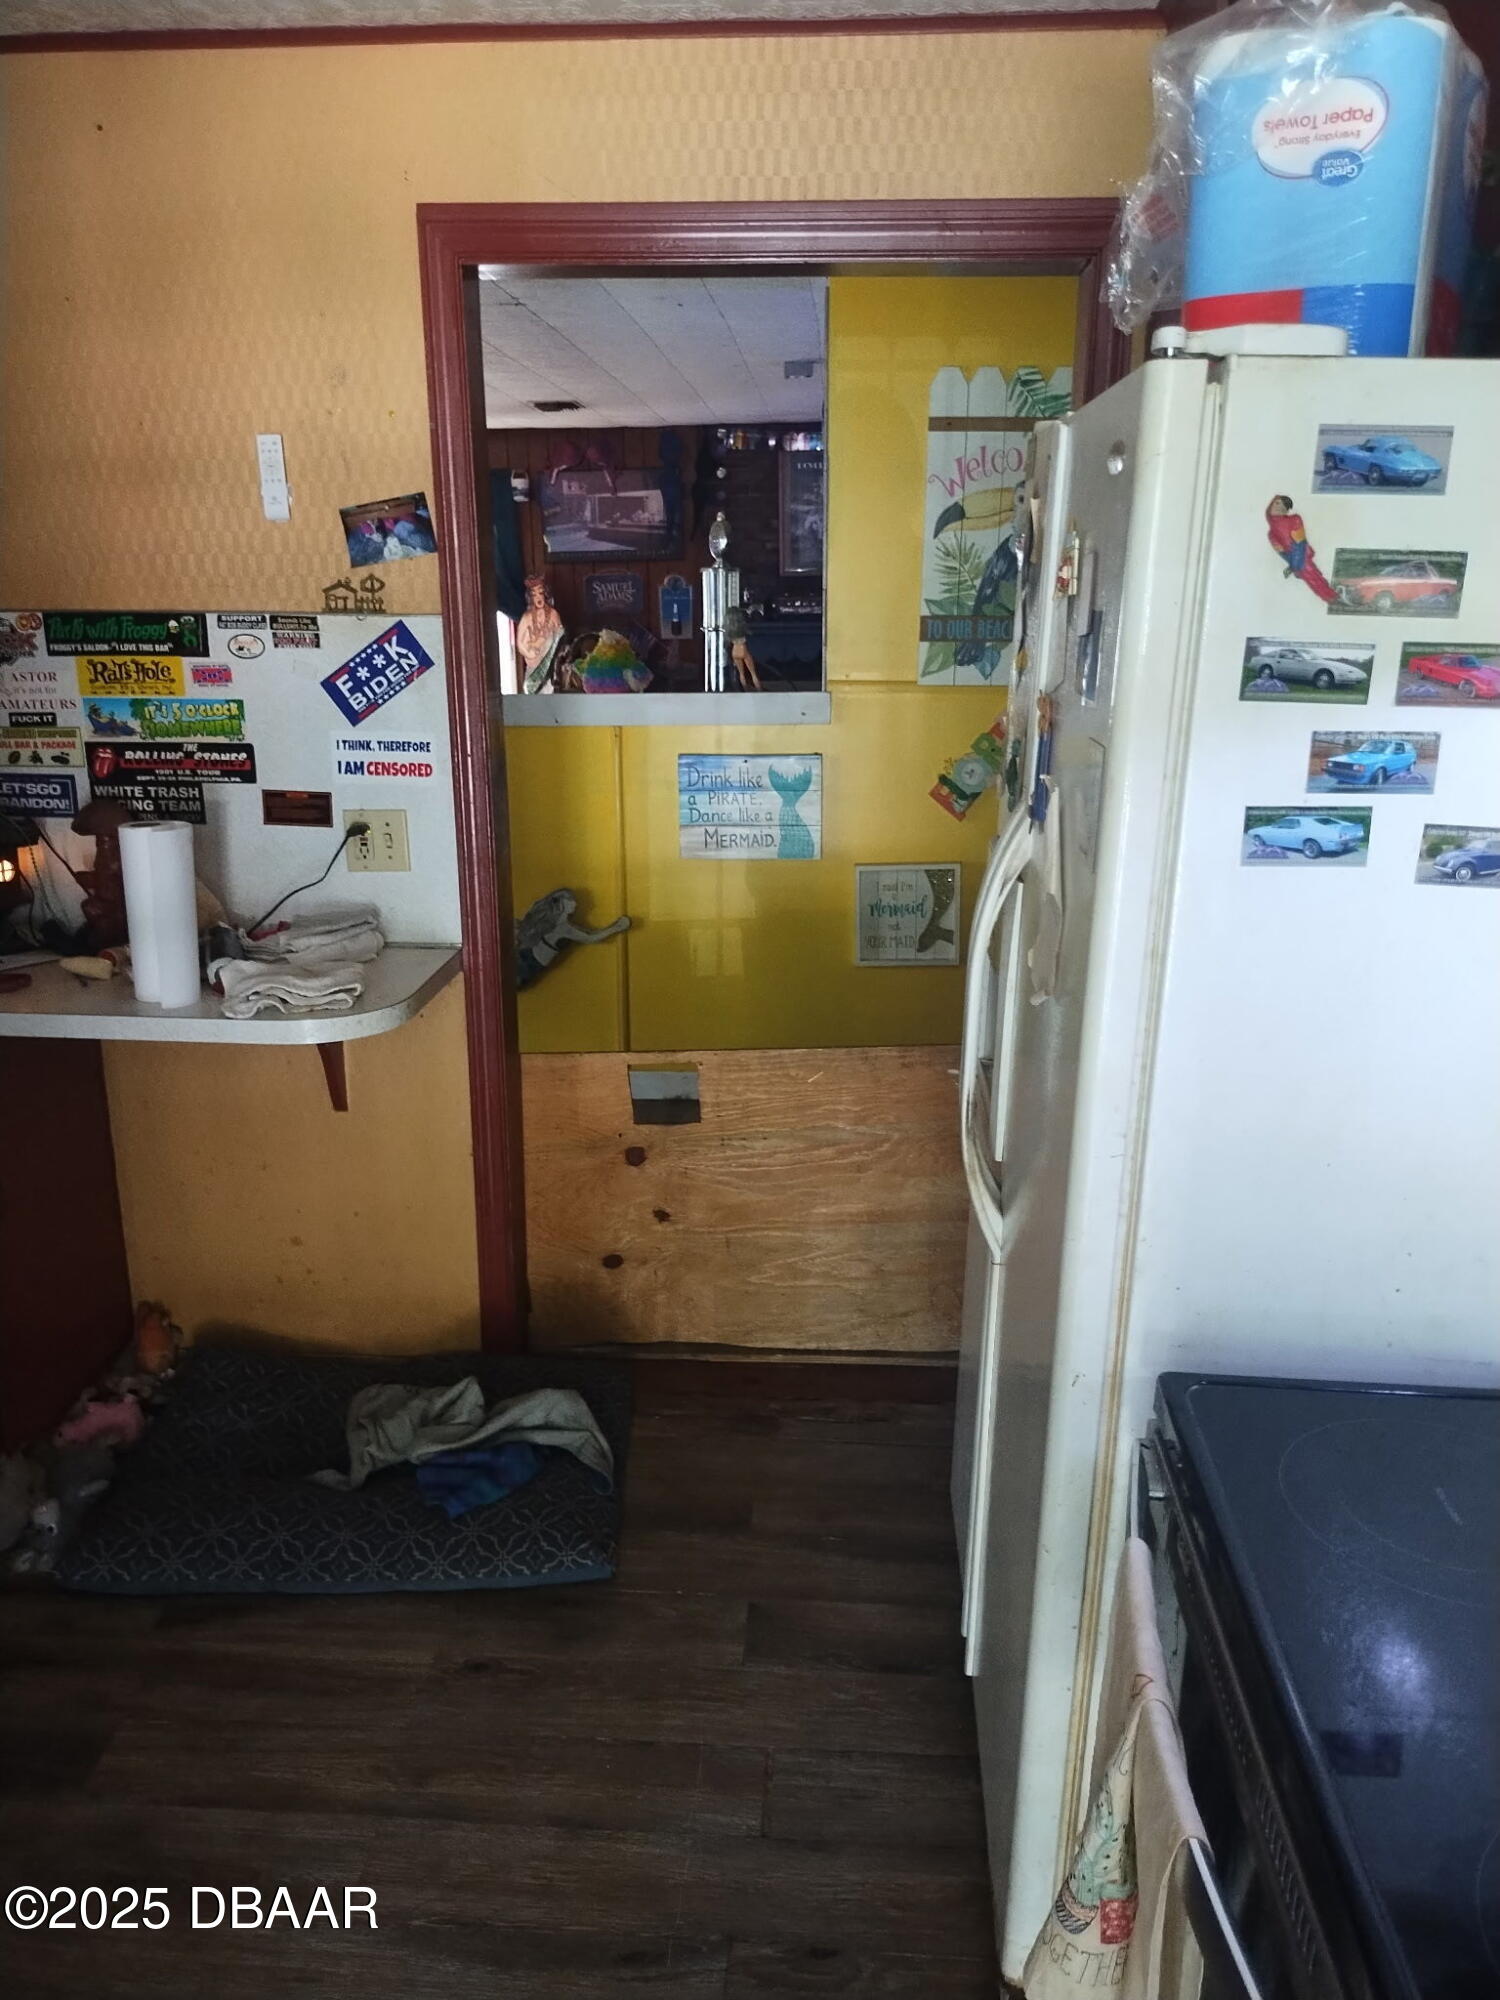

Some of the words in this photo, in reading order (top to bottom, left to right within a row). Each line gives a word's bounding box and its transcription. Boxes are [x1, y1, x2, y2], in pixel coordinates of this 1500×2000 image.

[1264, 114, 1318, 133] Towels
[1322, 107, 1374, 125] Paper
[1314, 130, 1361, 142] Everyday
[1321, 164, 1358, 179] Great
[928, 445, 1024, 498] Welco
[592, 581, 637, 593] SAMUEL
[598, 592, 633, 601] ADAMS
[86, 616, 118, 639] with
[120, 616, 167, 641] Froggy
[928, 620, 942, 639] TO
[946, 620, 972, 639] OUR
[976, 620, 1010, 639] BEAC
[120, 643, 137, 651] LOVE
[138, 643, 153, 651] THIS
[130, 658, 176, 684] Hole
[348, 652, 420, 713] BIDEN
[0, 699, 78, 710] AMATEURS
[172, 703, 182, 720] 5
[185, 702, 239, 718] O'CLOCK
[12, 715, 42, 723] FUCK
[43, 715, 54, 723] IT
[141, 719, 241, 738] SOMEWHERE
[183, 744, 198, 752] THE
[336, 740, 340, 751] I
[377, 740, 431, 753] THEREFORE
[124, 751, 184, 768] ROLLING
[193, 752, 248, 769] STONES
[337, 761, 341, 775] I
[344, 761, 364, 775] AM
[366, 761, 433, 777] CENSORED
[686, 764, 733, 788] Drink
[738, 767, 763, 788] like
[94, 786, 144, 798] WHITE
[148, 787, 200, 798] TRASH
[688, 794, 697, 805] a
[0, 797, 71, 810] RANDON!
[158, 800, 201, 812] TEAM
[689, 808, 733, 823] Dance
[739, 807, 762, 823] like
[765, 812, 774, 822] a
[868, 896, 928, 918] Mermaid
